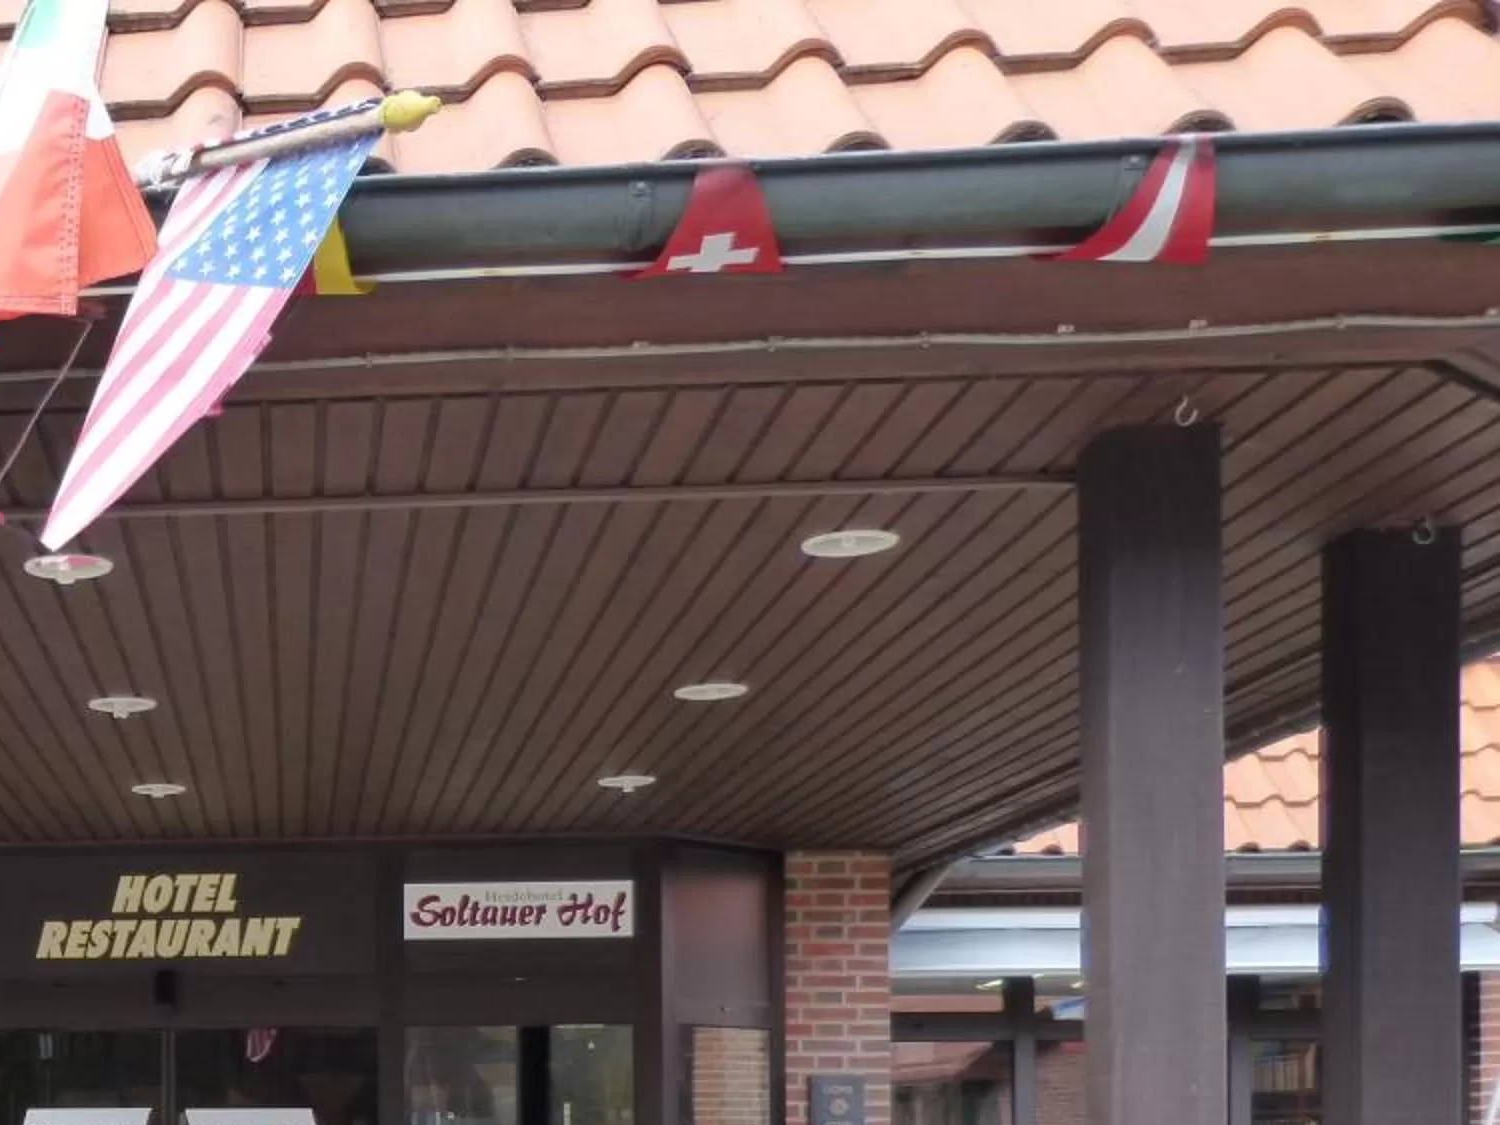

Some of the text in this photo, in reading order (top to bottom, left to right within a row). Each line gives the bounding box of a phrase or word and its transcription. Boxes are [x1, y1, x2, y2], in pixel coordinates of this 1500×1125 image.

[112, 873, 237, 914] HOTEL
[410, 891, 627, 932] Soltauer Hof
[36, 916, 301, 958] RESTAURANT
